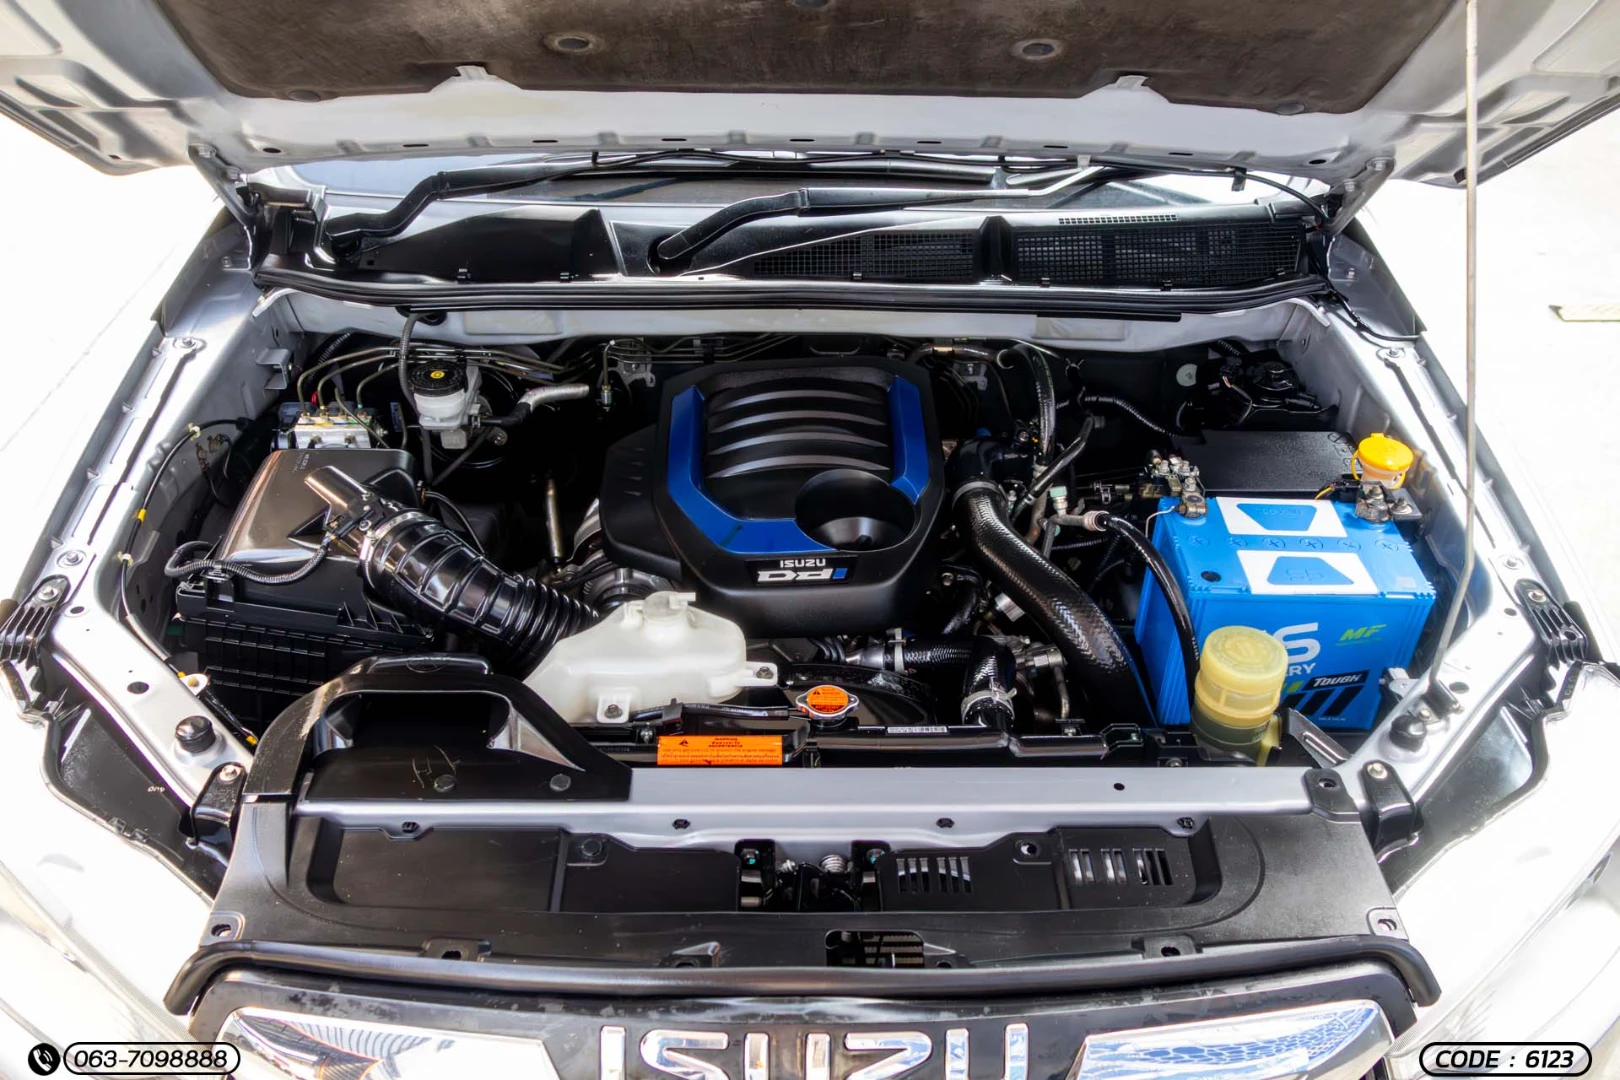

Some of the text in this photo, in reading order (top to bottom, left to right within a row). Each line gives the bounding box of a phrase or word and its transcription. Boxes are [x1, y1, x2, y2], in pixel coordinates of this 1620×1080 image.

[780, 558, 826, 568] ISUZU
[1339, 623, 1387, 641] MF
[601, 1022, 1030, 1080] ISUZU
